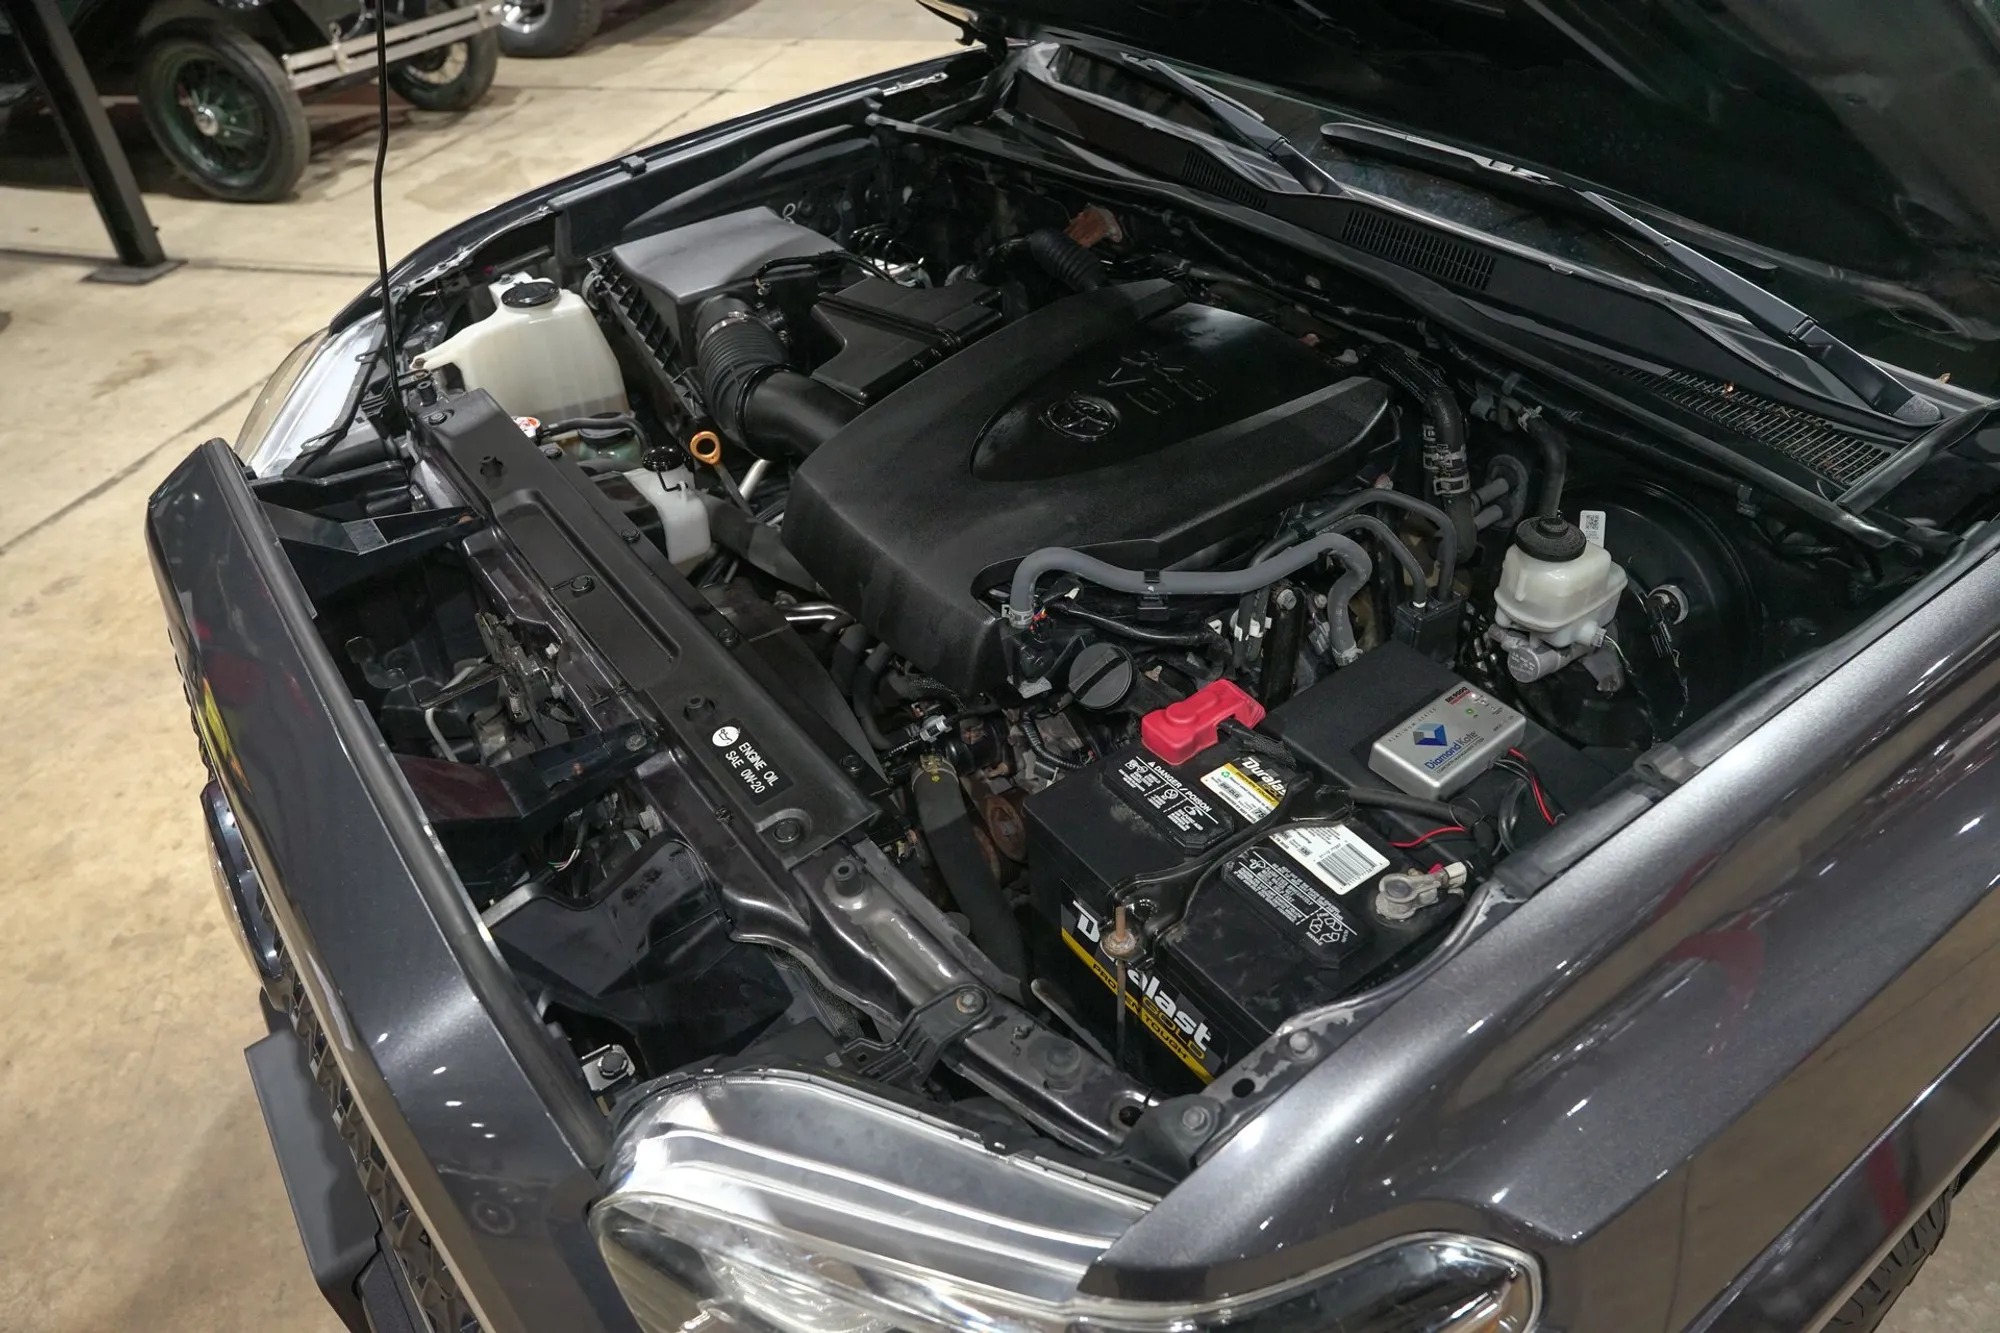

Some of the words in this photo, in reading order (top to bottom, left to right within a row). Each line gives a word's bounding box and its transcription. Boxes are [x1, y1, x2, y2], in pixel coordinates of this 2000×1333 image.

[725, 750, 744, 768] SAE
[740, 768, 765, 793] 0W-20
[739, 742, 767, 771] ENGINE
[763, 771, 779, 786] OIL
[1154, 765, 1182, 788] DANGER
[1185, 791, 1212, 812] POISON
[1073, 900, 1212, 1052] Dalast
[1092, 963, 1141, 1013] PROEN
[1144, 1016, 1188, 1060] TOUGH
[1142, 995, 1205, 1060] GOLD
